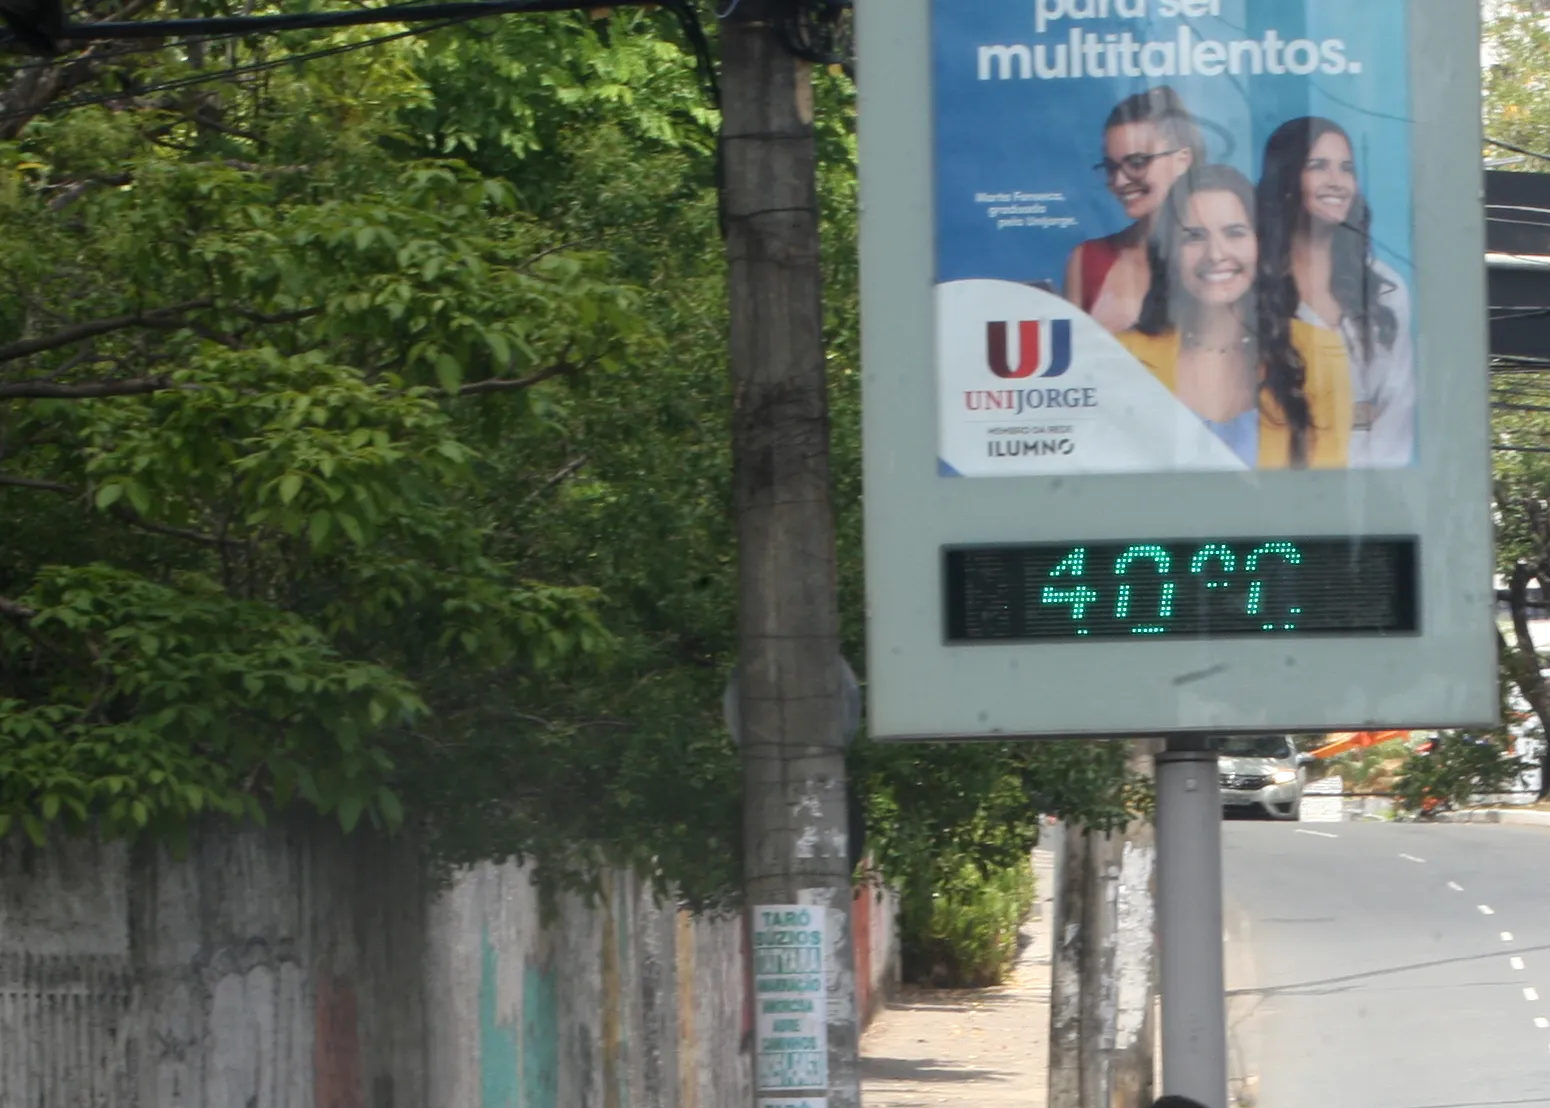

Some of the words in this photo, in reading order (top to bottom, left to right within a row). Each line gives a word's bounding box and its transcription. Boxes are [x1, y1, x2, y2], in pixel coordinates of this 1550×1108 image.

[977, 26, 1362, 80] multitalentos.
[964, 387, 1098, 415] UNIJORGE
[987, 438, 1075, 457] ILUMNO
